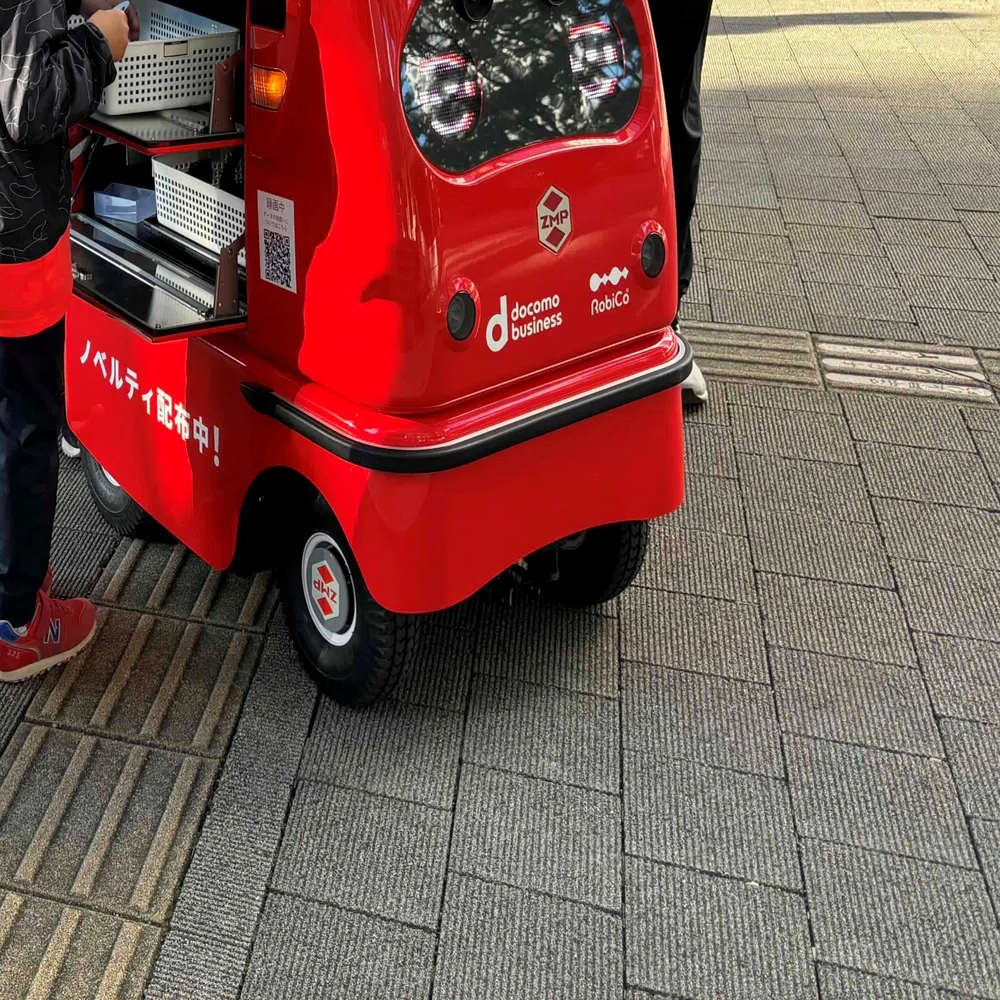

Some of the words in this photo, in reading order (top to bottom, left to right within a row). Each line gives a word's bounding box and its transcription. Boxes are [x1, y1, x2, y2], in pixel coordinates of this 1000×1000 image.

[539, 209, 569, 230] ZMP
[511, 294, 560, 322] docomo
[591, 291, 630, 316] RobiCo
[511, 311, 563, 341] business
[313, 579, 338, 605] ZMP
[43, 618, 61, 644] N
